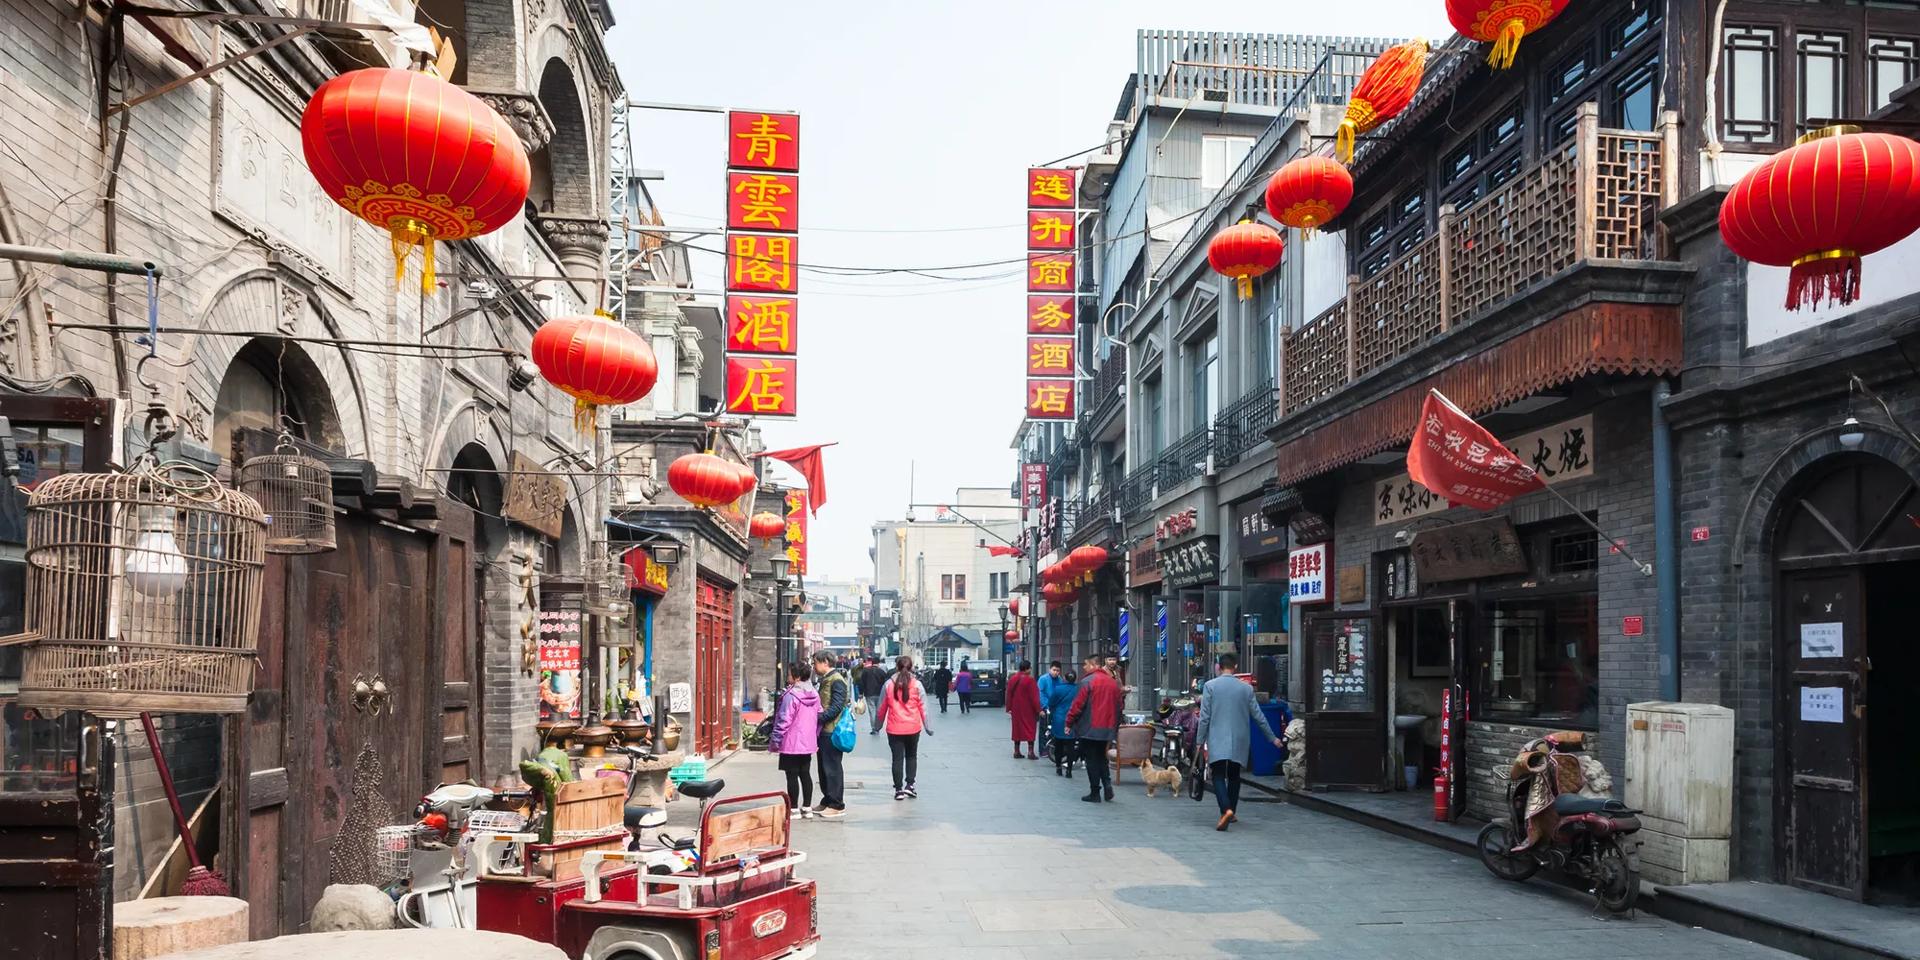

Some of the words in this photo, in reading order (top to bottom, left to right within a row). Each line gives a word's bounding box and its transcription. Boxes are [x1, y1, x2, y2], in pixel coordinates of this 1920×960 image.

[730, 113, 793, 413] 青雲閣酒店
[1030, 174, 1074, 414] 连升商务酒店
